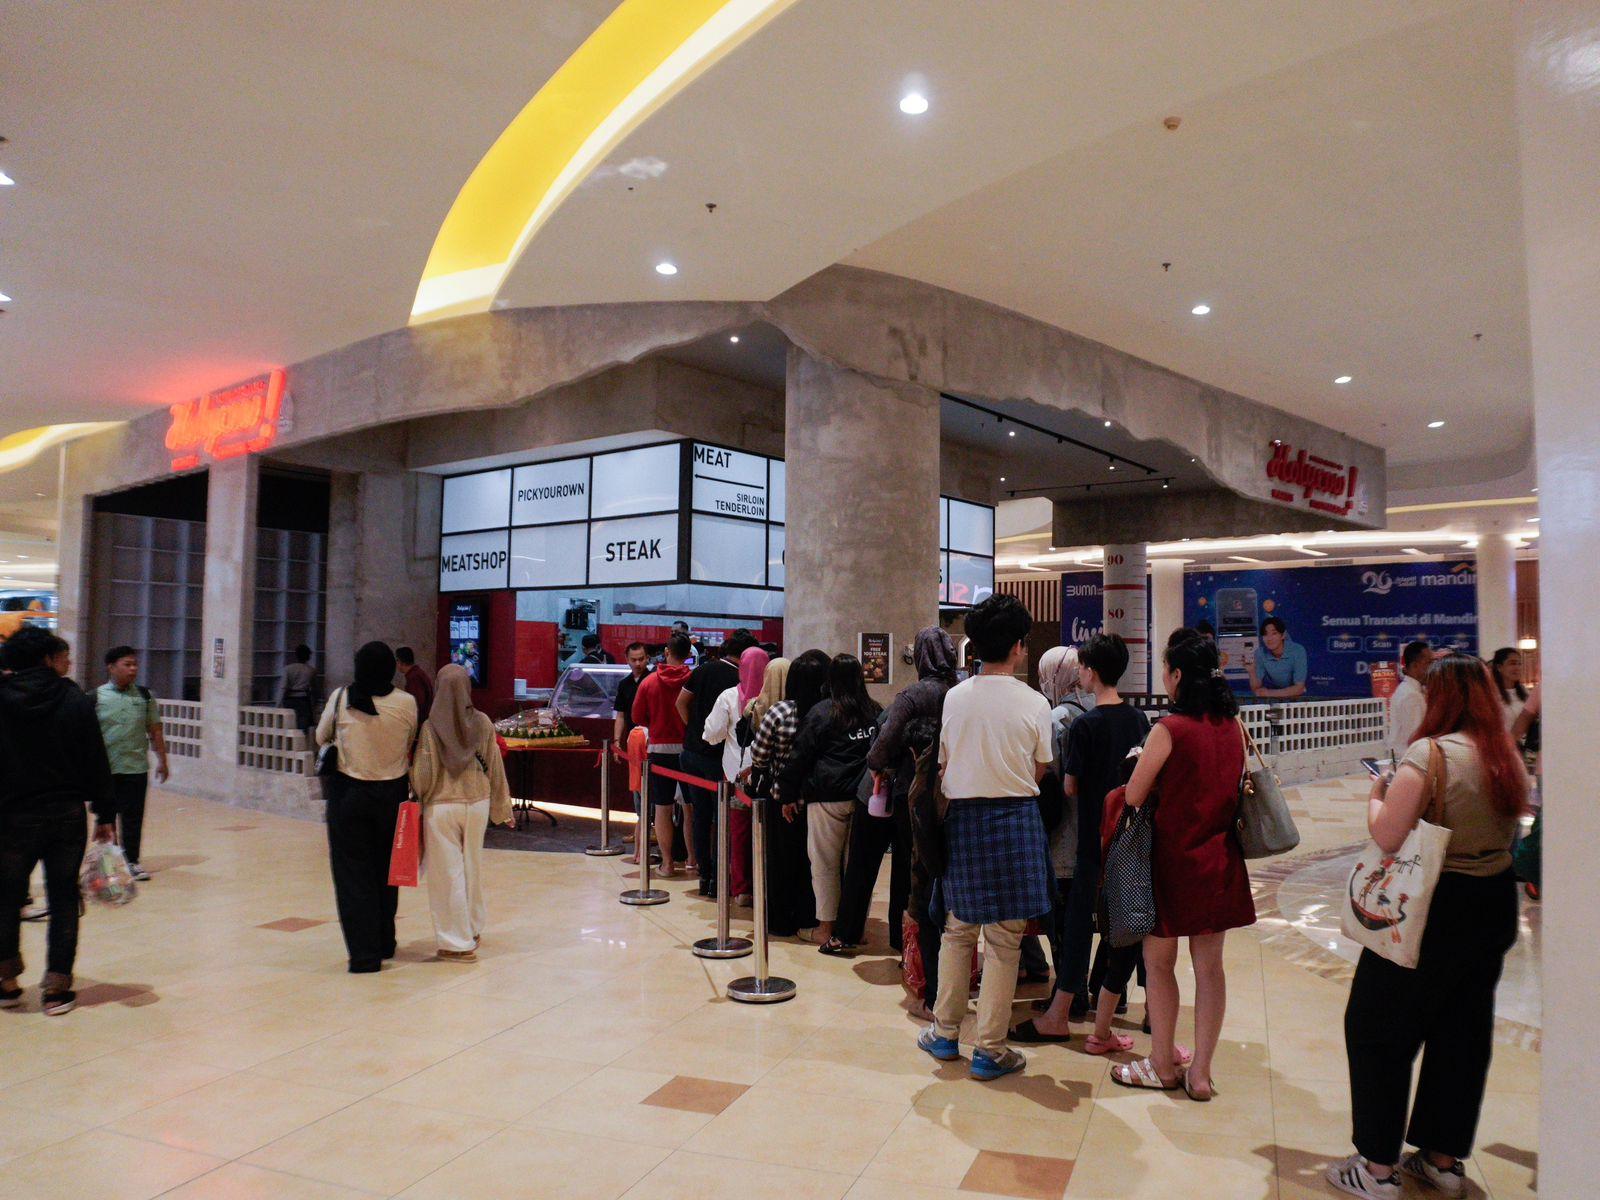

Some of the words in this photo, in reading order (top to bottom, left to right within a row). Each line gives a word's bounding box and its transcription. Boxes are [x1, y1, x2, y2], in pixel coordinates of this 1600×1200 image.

[693, 445, 732, 468] MEAT
[517, 482, 585, 502] PICKYOUROWN
[736, 493, 765, 506] SIRLOIN
[715, 500, 765, 517] TENDERLOIN
[605, 538, 662, 562] STEAK
[441, 550, 507, 573] MEATSHOP
[1107, 554, 1124, 566] 90
[1421, 572, 1477, 586] mandir
[1107, 608, 1125, 620] 80
[1322, 615, 1361, 626] Semua
[1362, 613, 1418, 626] Transaksi
[1419, 613, 1432, 625] di
[1434, 613, 1478, 625] Mandir
[1333, 640, 1356, 649] Bayar
[1372, 640, 1392, 648] Scan
